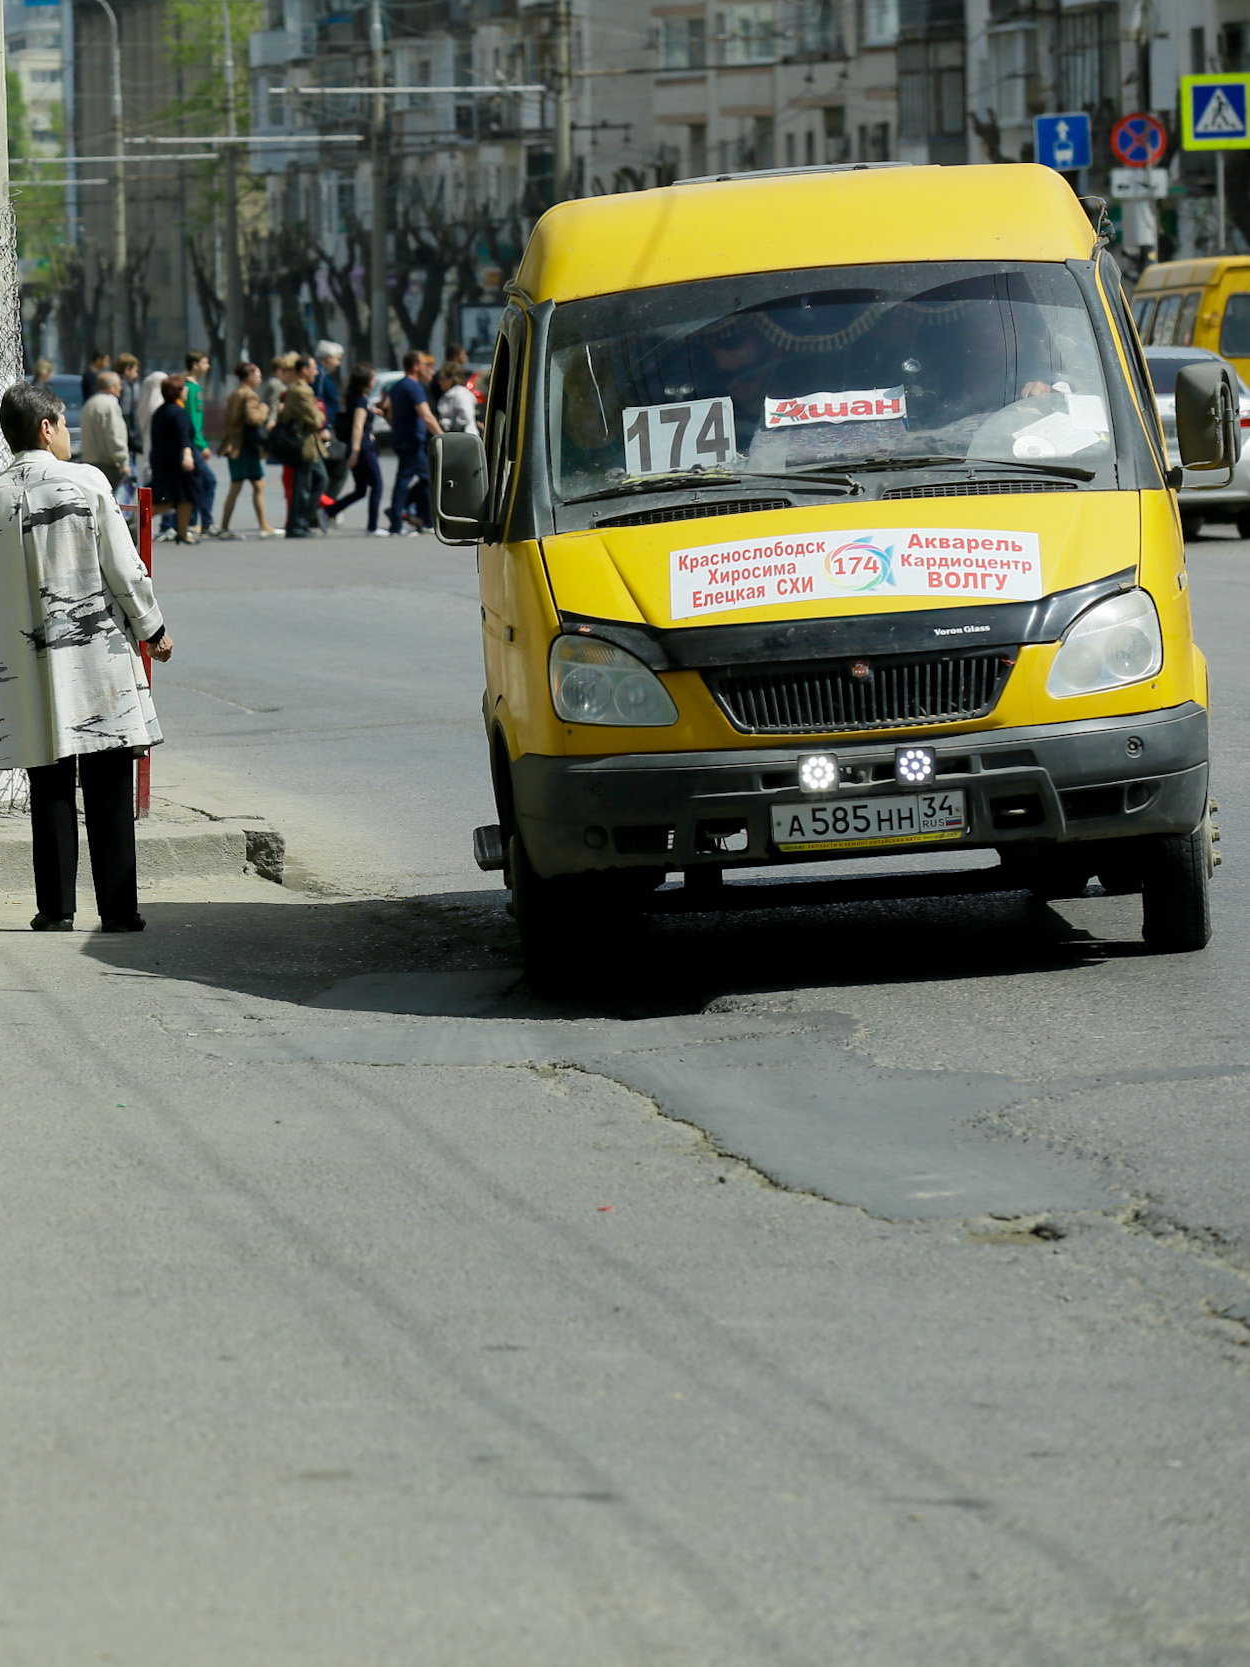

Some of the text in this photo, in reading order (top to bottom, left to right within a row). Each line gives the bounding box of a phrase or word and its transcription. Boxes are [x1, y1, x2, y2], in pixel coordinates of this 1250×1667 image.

[627, 401, 730, 472] 174
[908, 533, 1023, 553] Акварель
[679, 541, 826, 573] Краснослободск
[833, 556, 879, 575] 174
[901, 554, 1032, 574] Кардиоцентр
[707, 562, 797, 586] Хиросима
[928, 572, 1007, 590] ВОЛГУ
[692, 576, 813, 609] Елецкая СХИ
[934, 625, 991, 636] Voron Glass
[922, 795, 953, 818] 34
[922, 818, 945, 828] RUS
